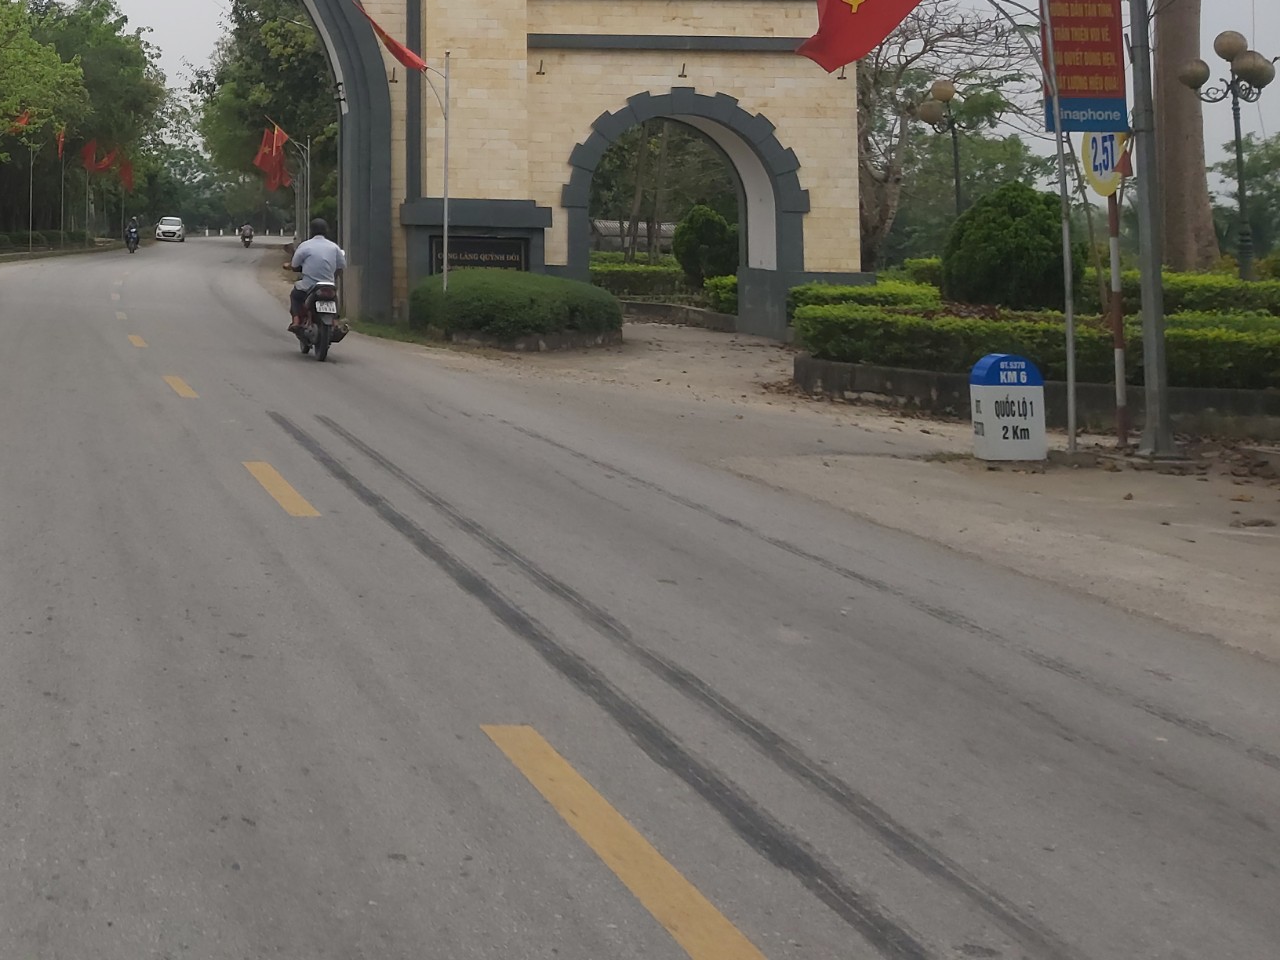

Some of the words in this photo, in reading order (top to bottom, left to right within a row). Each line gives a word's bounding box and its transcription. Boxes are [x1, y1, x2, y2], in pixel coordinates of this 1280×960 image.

[1052, 107, 1121, 123] inaphone
[1091, 134, 1115, 176] 2,5T
[1000, 371, 1017, 383] KM
[1020, 371, 1027, 383] 6
[994, 394, 1016, 419] QUỐC
[1017, 397, 1028, 420] LỘ
[1029, 400, 1034, 417] 1
[1002, 425, 1009, 440] 2
[1012, 425, 1030, 440] Km
